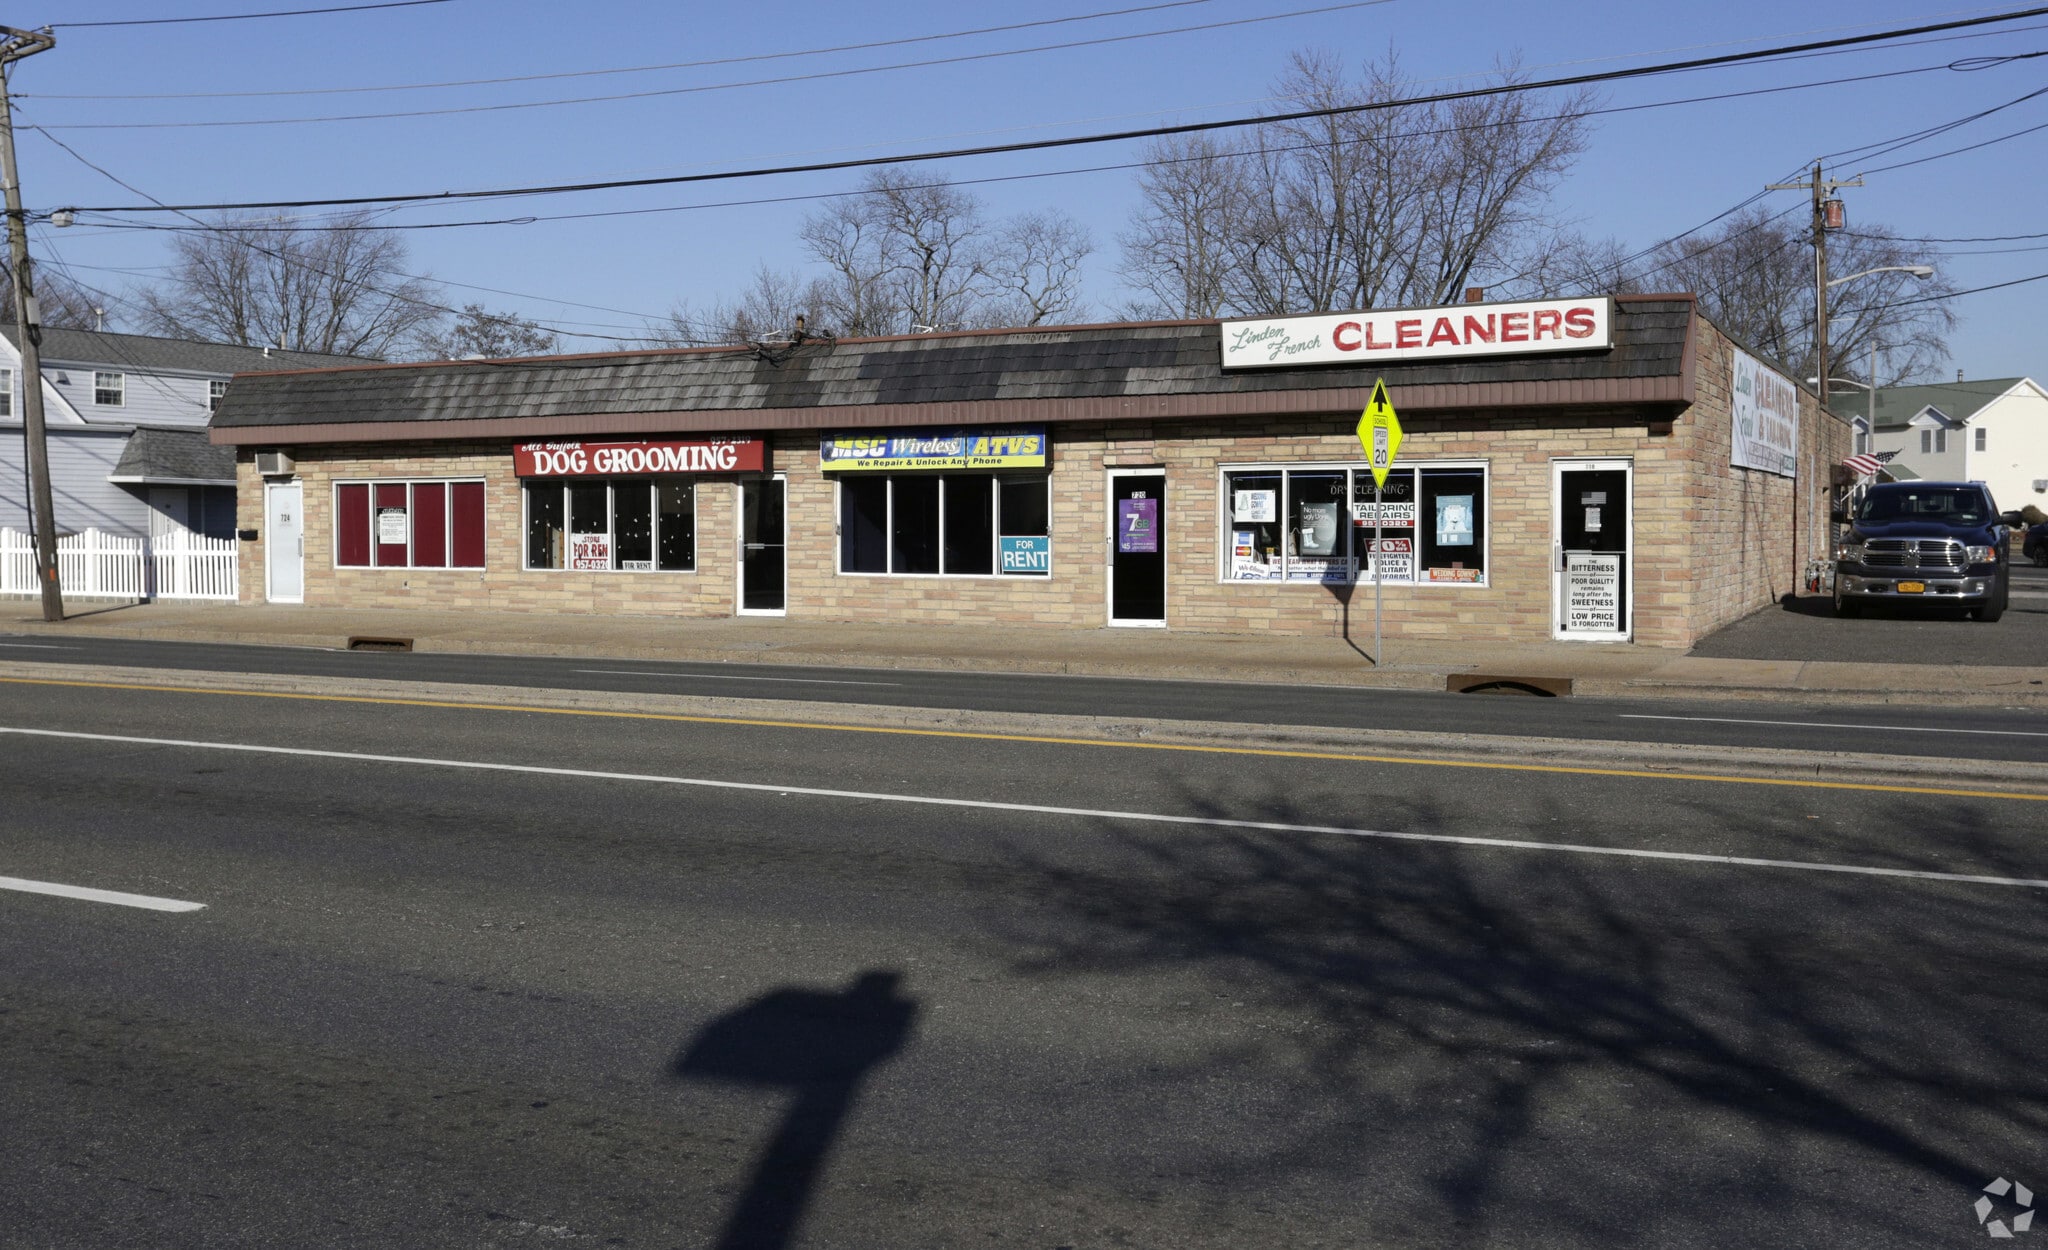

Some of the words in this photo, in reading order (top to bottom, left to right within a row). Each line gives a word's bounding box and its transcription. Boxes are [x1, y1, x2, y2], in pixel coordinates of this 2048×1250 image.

[1332, 306, 1596, 351] CLEANERS
[1229, 325, 1285, 352] Linden
[1267, 335, 1321, 360] French
[831, 435, 887, 457] MSC
[891, 437, 959, 455] Wireless
[973, 435, 1040, 455] ATVS
[1376, 438, 1386, 446] LIMIT
[533, 449, 588, 475] DOG
[593, 445, 738, 473] GROOMING
[873, 459, 903, 467] Repair
[1375, 449, 1387, 464] 20
[573, 543, 589, 557] FOR
[591, 543, 608, 557] REN
[1015, 540, 1034, 549] FOR
[1003, 551, 1048, 567] RENT
[1571, 564, 1615, 572] BITTERNESS
